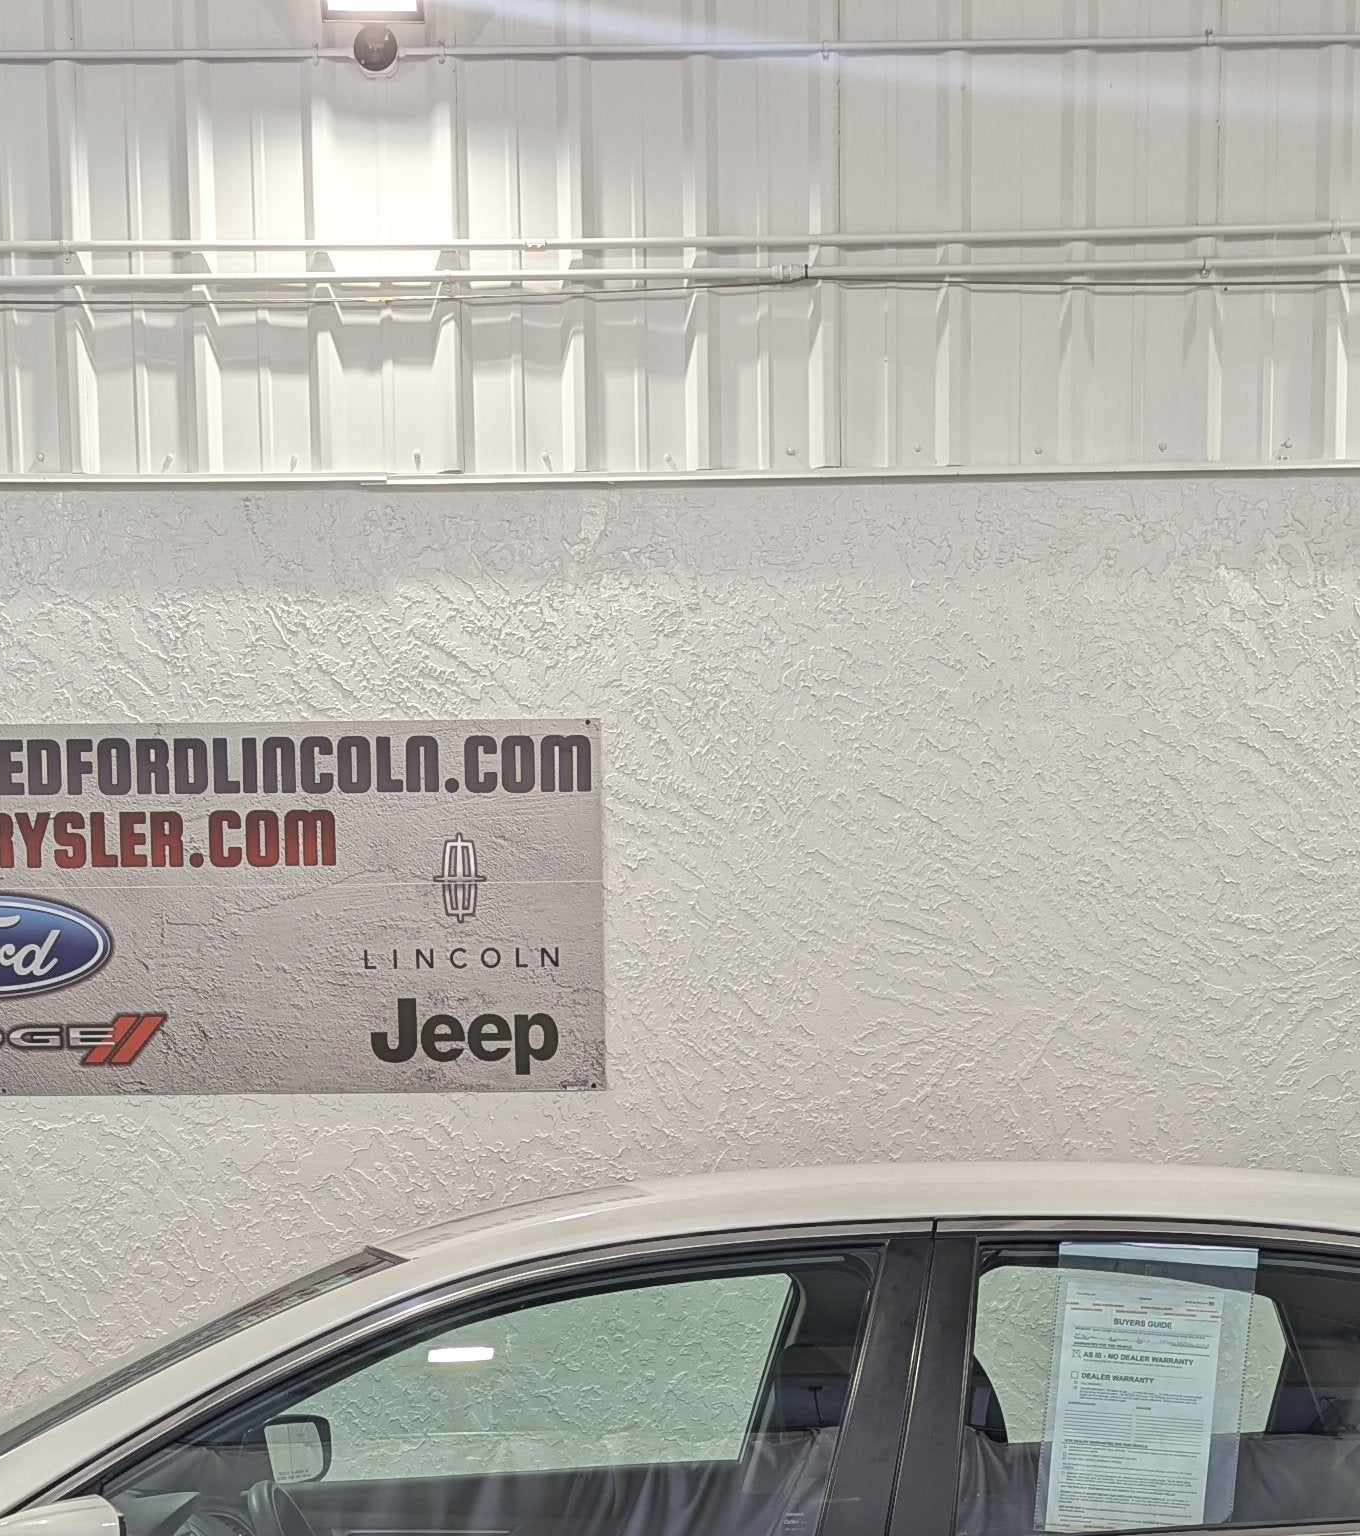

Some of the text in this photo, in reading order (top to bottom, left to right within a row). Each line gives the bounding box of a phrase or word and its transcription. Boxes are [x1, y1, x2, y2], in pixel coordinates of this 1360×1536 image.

[363, 946, 560, 969] LINCOLN
[370, 997, 559, 1075] Jeep
[1113, 1317, 1173, 1330] BUYERS GUIDE
[1082, 1351, 1094, 1359] AS
[1120, 1354, 1150, 1363] DEALER
[1151, 1356, 1195, 1366] WARRANTY
[1081, 1372, 1111, 1381] DEALER
[1112, 1374, 1155, 1384] WARRANTY
